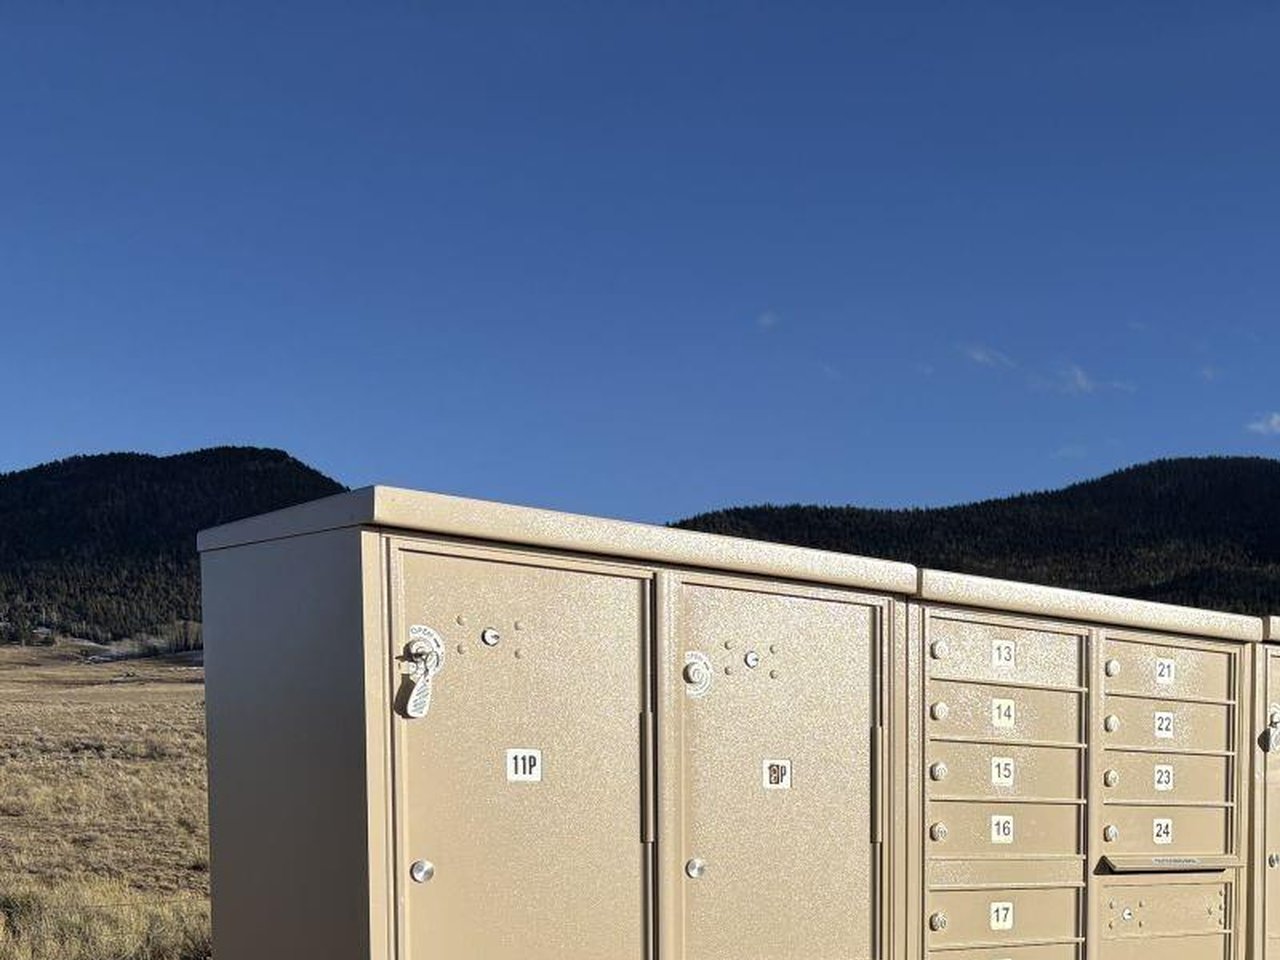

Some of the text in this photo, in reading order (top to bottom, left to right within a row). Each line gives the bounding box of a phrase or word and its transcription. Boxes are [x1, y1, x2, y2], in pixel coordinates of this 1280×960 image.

[410, 626, 434, 637] OPEN
[996, 646, 1012, 662] 13
[1157, 662, 1171, 678] 21
[995, 703, 1012, 720] 14
[1157, 716, 1172, 732] 22
[513, 754, 537, 775] 11P
[994, 762, 1011, 779] 15
[1156, 769, 1171, 785] 23
[994, 820, 1011, 836] 16
[1155, 823, 1170, 838] 24
[993, 906, 1010, 922] 17
